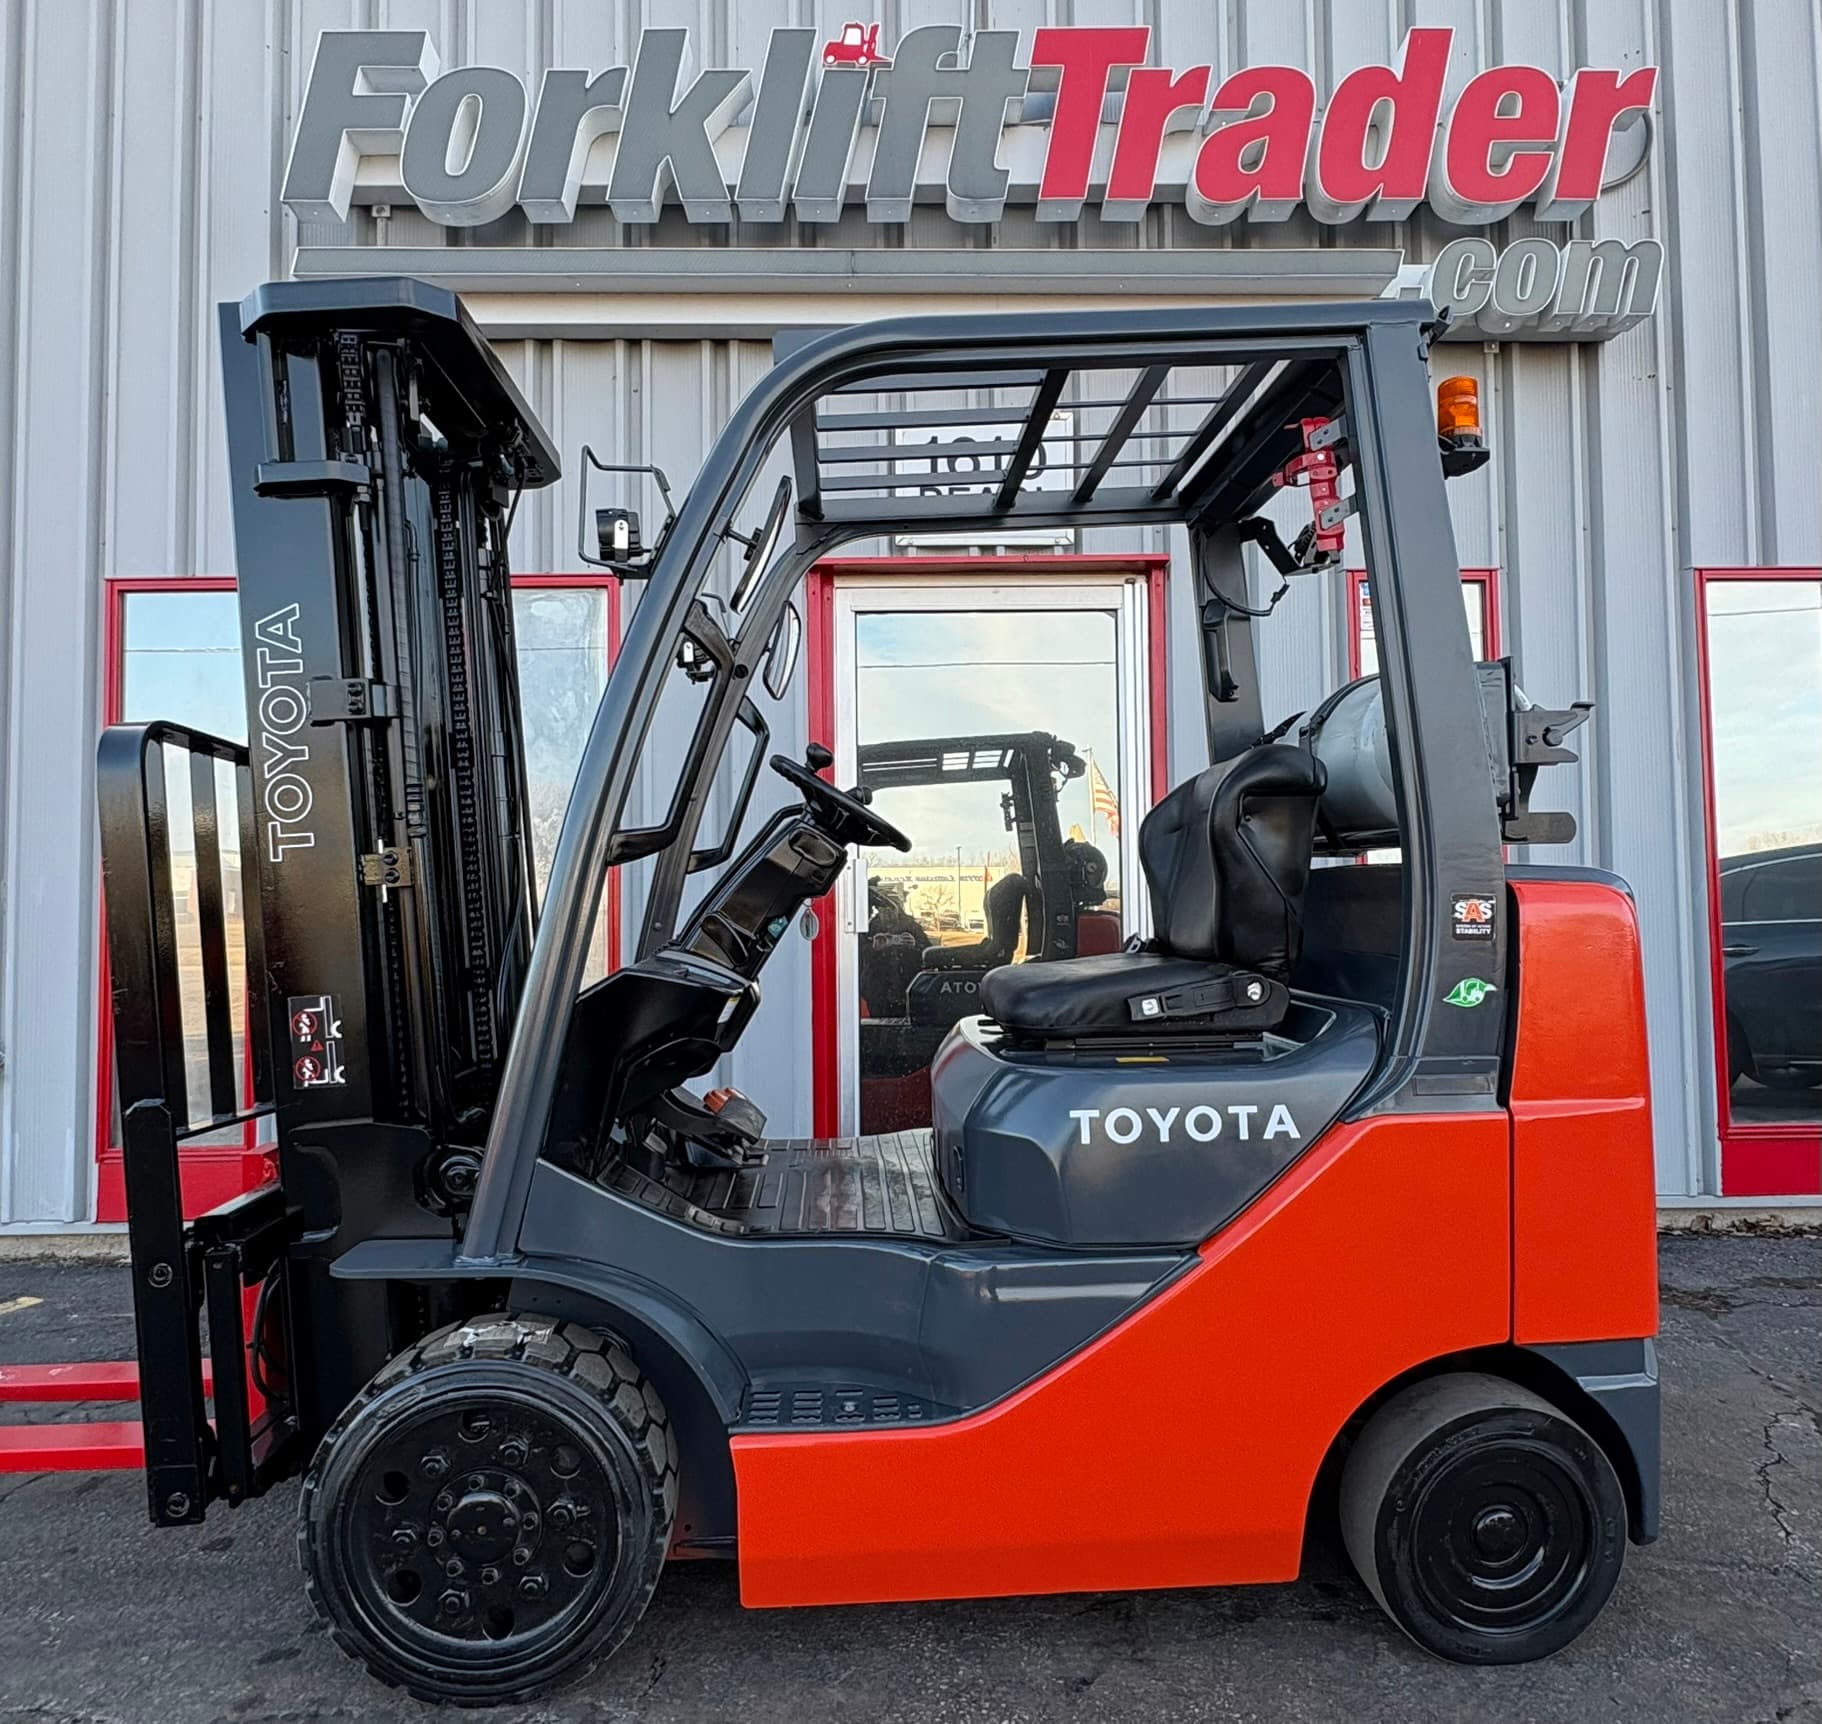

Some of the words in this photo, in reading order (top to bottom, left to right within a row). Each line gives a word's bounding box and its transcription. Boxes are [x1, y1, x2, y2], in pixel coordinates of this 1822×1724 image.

[255, 602, 315, 863] TOYOTA
[1454, 899, 1492, 922] SAS
[1069, 1103, 1301, 1145] TOYOTA
